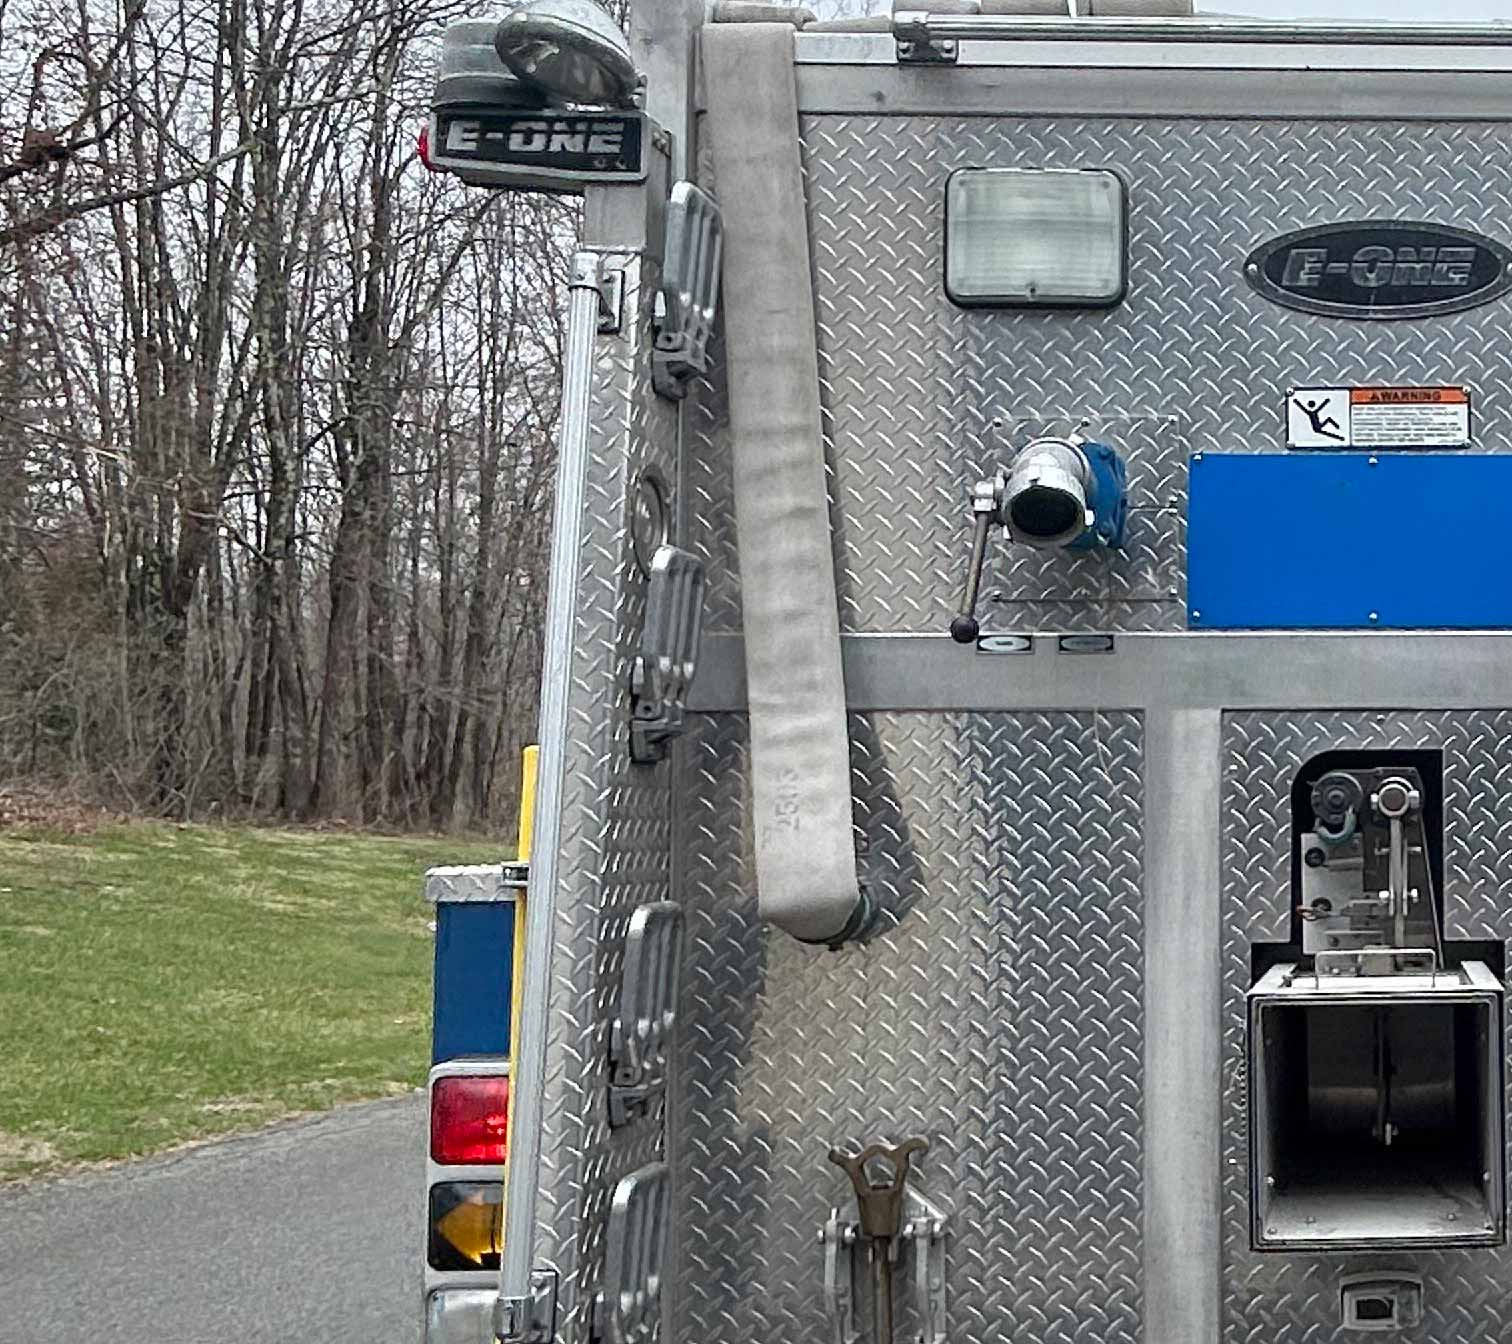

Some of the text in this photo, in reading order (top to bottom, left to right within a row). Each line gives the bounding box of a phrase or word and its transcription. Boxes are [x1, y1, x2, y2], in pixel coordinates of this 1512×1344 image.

[446, 119, 625, 154] E-ONE
[1281, 245, 1477, 288] E-ONE
[1381, 391, 1441, 401] WARNING
